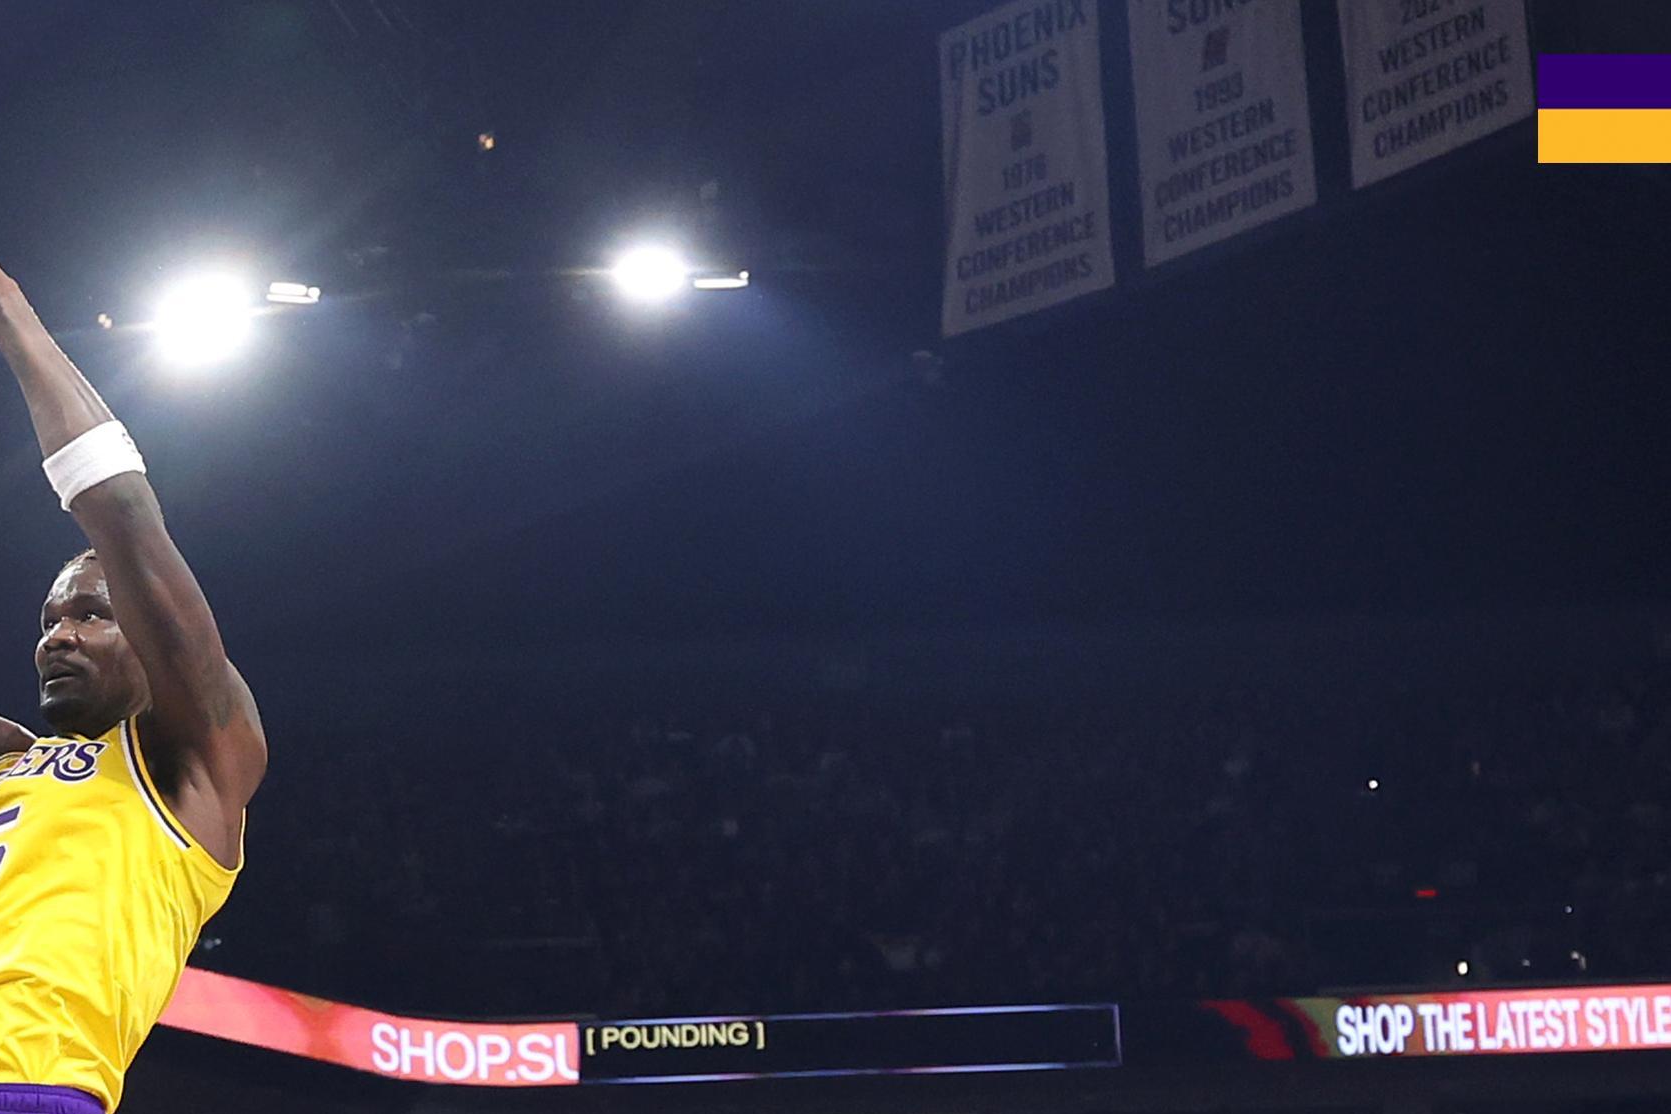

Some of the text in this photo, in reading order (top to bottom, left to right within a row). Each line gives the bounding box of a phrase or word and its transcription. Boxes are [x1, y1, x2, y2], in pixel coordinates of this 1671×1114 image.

[949, 0, 1086, 81] PHOENIX
[1167, 0, 1251, 34] SU
[1379, 6, 1485, 73] WESTERN
[1400, 0, 1455, 25] 20
[977, 49, 1059, 116] SUNS
[1363, 34, 1512, 122] CONFERENCE
[1167, 96, 1275, 163] WESTERN
[1374, 79, 1508, 158] CHAMPIONS
[1155, 128, 1298, 208] CONFERENCE
[974, 181, 1075, 238] WESTERN
[1164, 169, 1294, 242] CHAMPIONS
[957, 211, 1095, 280] CONFERENCE
[965, 252, 1093, 314] CHAMPIONS
[1335, 995, 1671, 1056] SHOP THE LATEST STYLE
